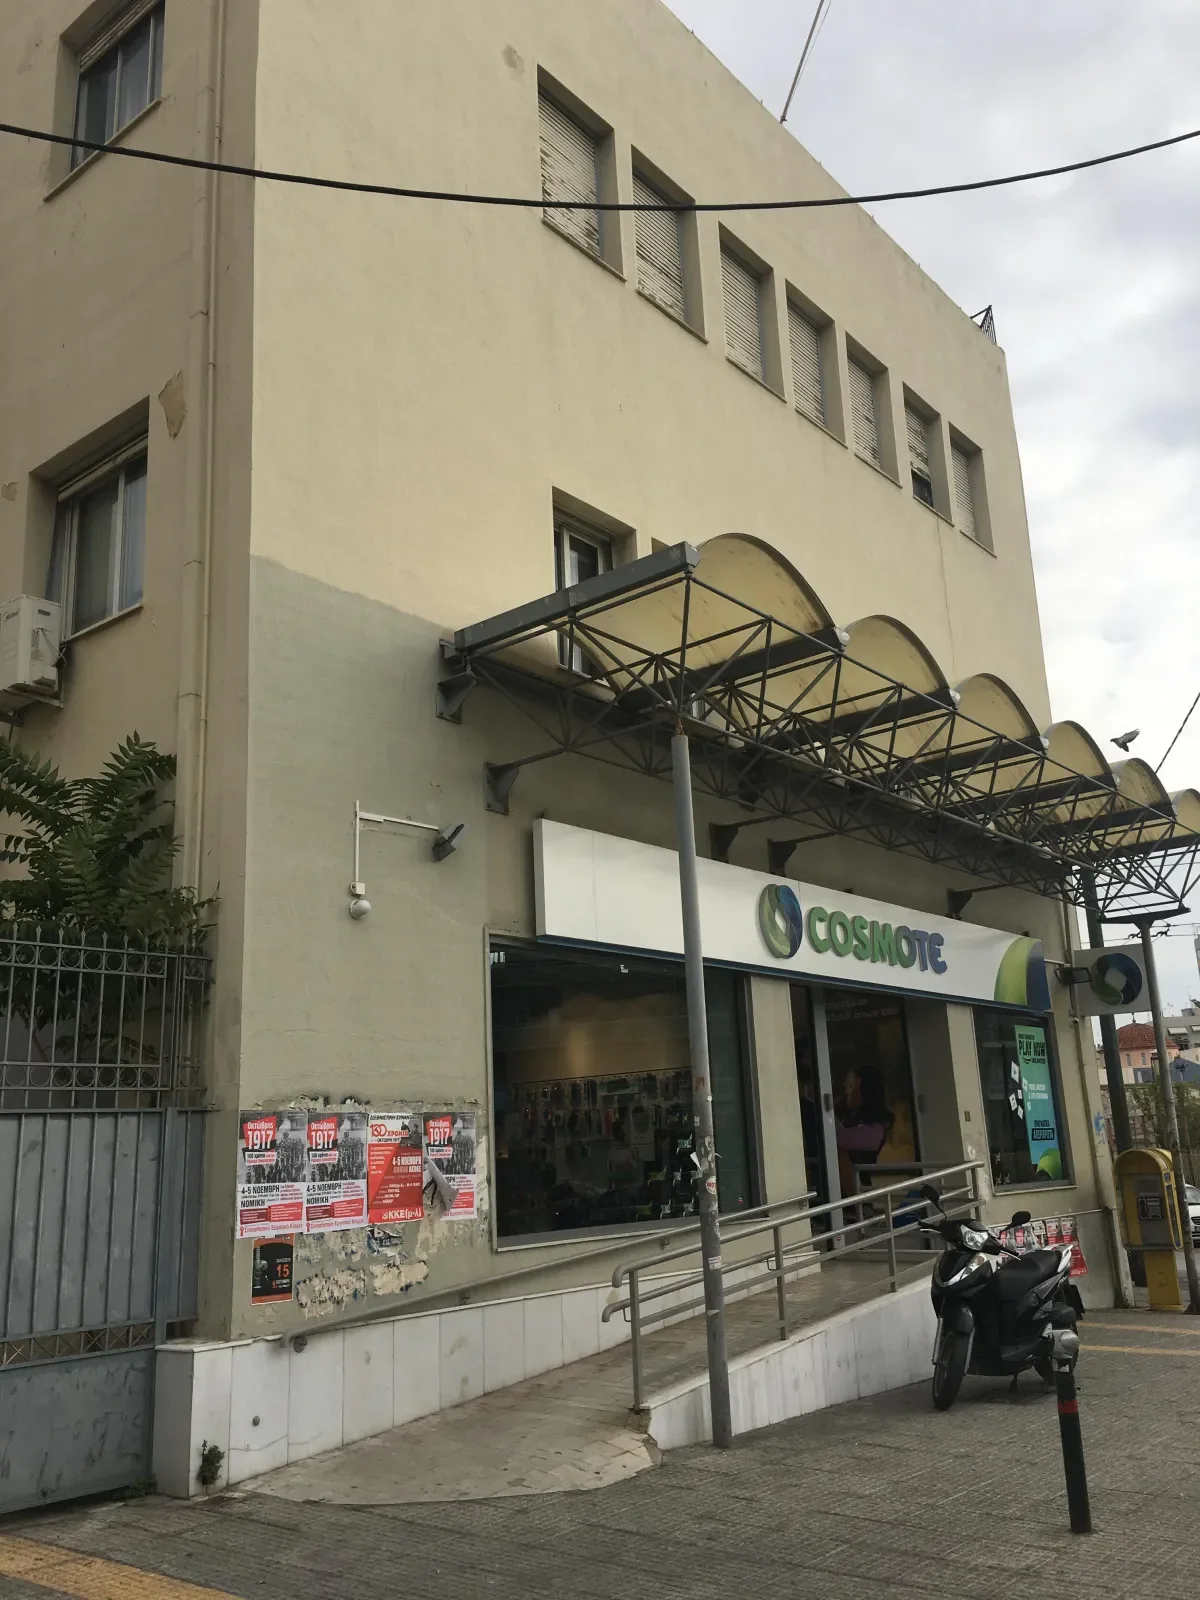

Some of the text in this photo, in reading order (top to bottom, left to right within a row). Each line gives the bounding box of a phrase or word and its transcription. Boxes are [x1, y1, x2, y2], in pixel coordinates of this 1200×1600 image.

[808, 906, 948, 975] COSMOTE
[247, 1121, 274, 1130] Οκτώβρης
[310, 1121, 335, 1130] Οκτώβρης
[387, 1130, 409, 1138] ΧΡΟΝΙΑ
[430, 1128, 450, 1146] 1917
[247, 1130, 274, 1150] 1917
[311, 1130, 335, 1150] 1917
[392, 1156, 401, 1166] 4-5
[241, 1186, 252, 1194] 4-5
[252, 1184, 280, 1194] ΝΟΕΜΒΡΗ
[306, 1184, 316, 1193] 4-5
[317, 1182, 342, 1192] ΝΟΕΜΒΡΗ
[240, 1199, 266, 1208] ΝΟΜΙΚΗ
[306, 1195, 329, 1206] ΝΟΜΙΚΗ
[388, 1207, 422, 1220] ΚΚΕ(μ-λ)
[276, 1264, 290, 1278] 15
